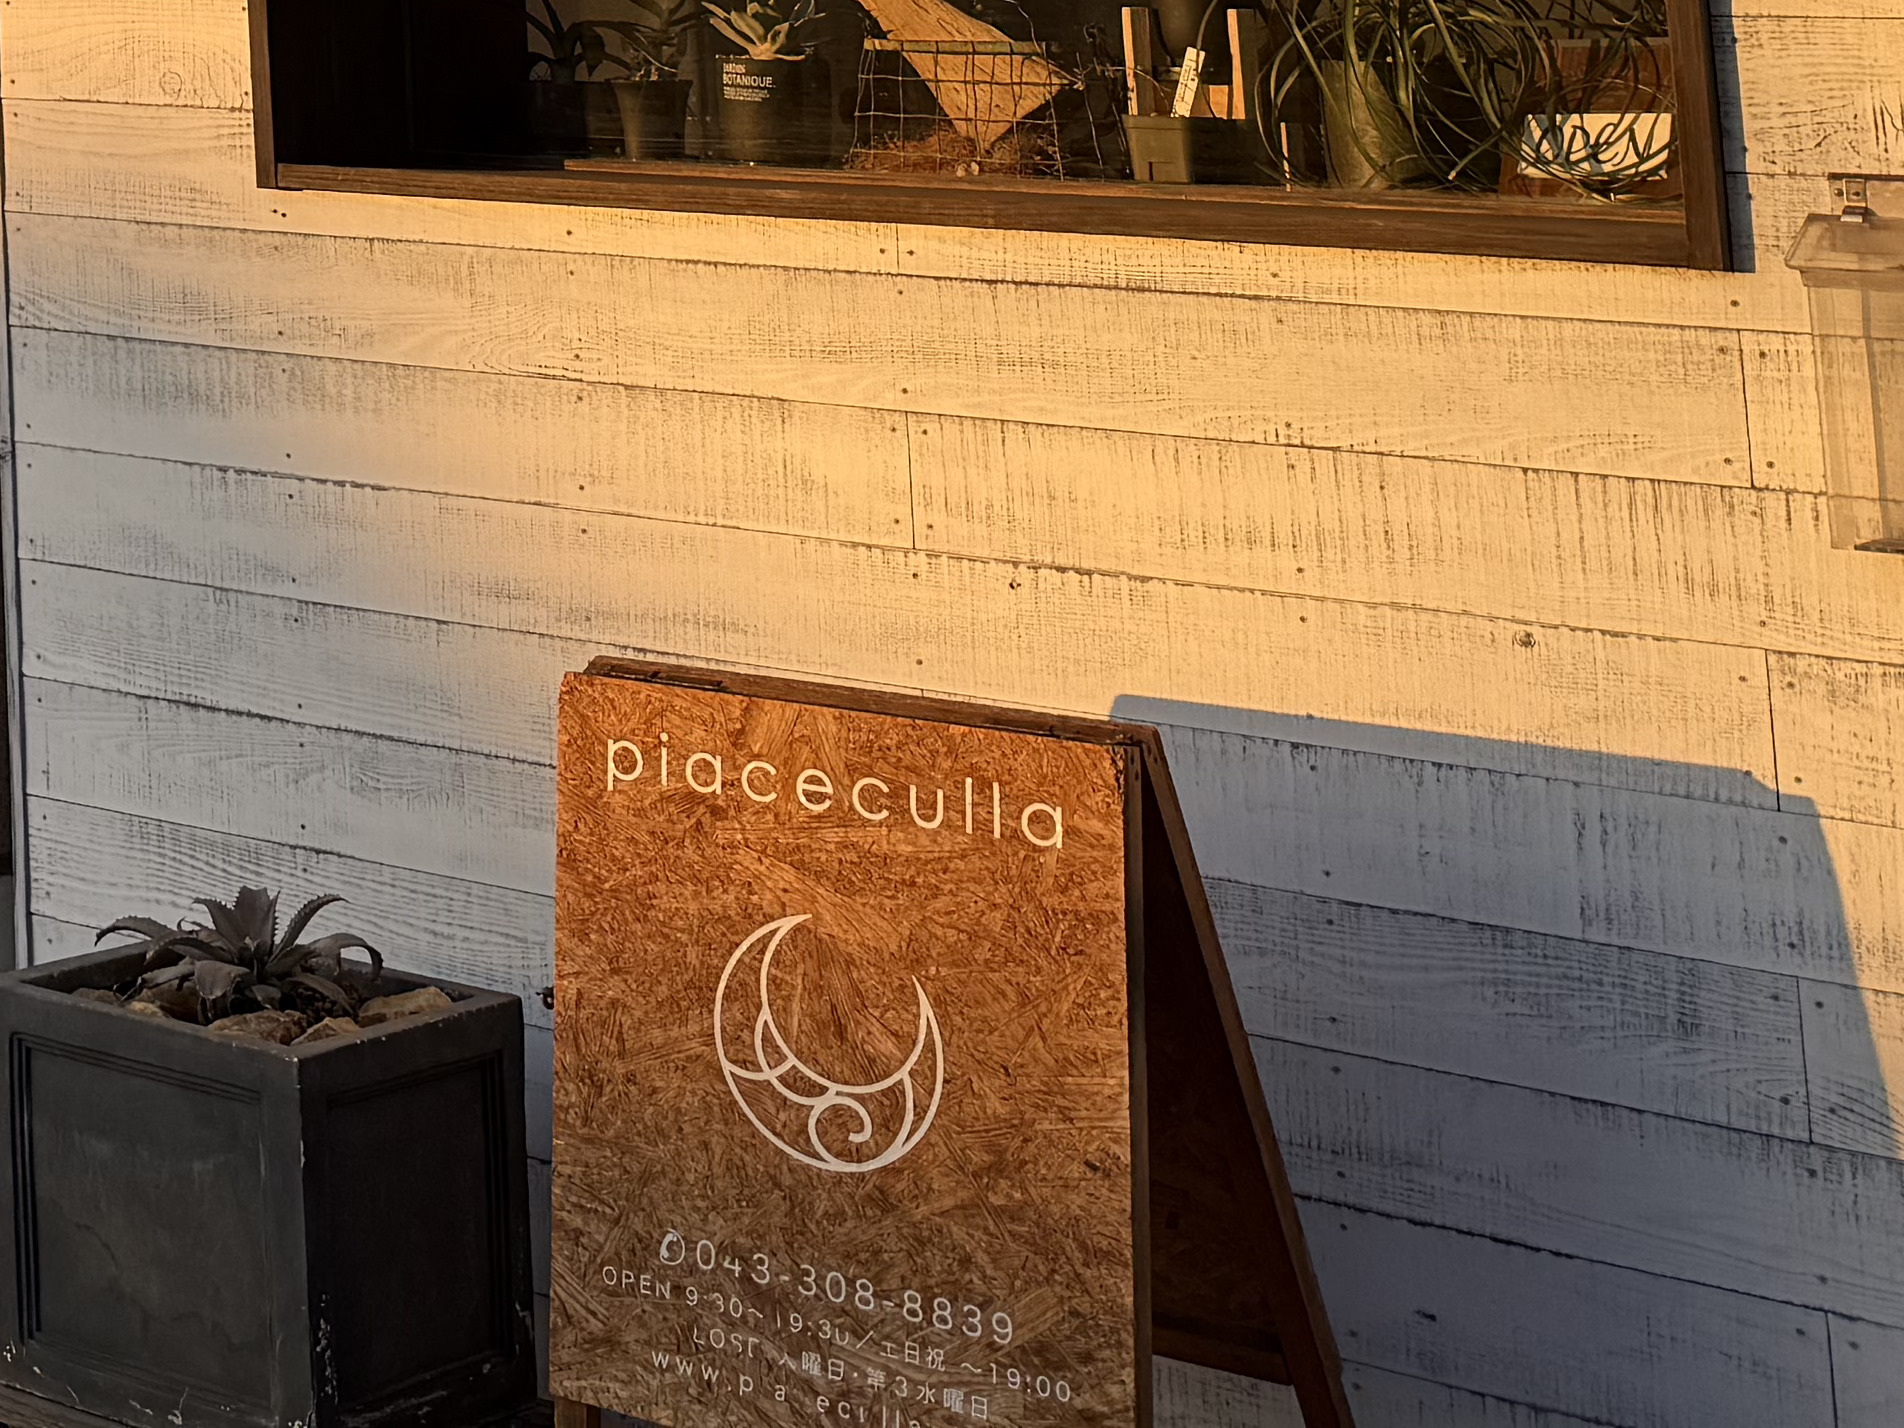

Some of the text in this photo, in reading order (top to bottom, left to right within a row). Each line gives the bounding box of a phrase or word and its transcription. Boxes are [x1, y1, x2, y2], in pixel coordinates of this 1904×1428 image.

[606, 731, 1063, 849] piaceculla
[602, 1265, 671, 1300] OPEN
[696, 1239, 1013, 1344] 043-308-8839
